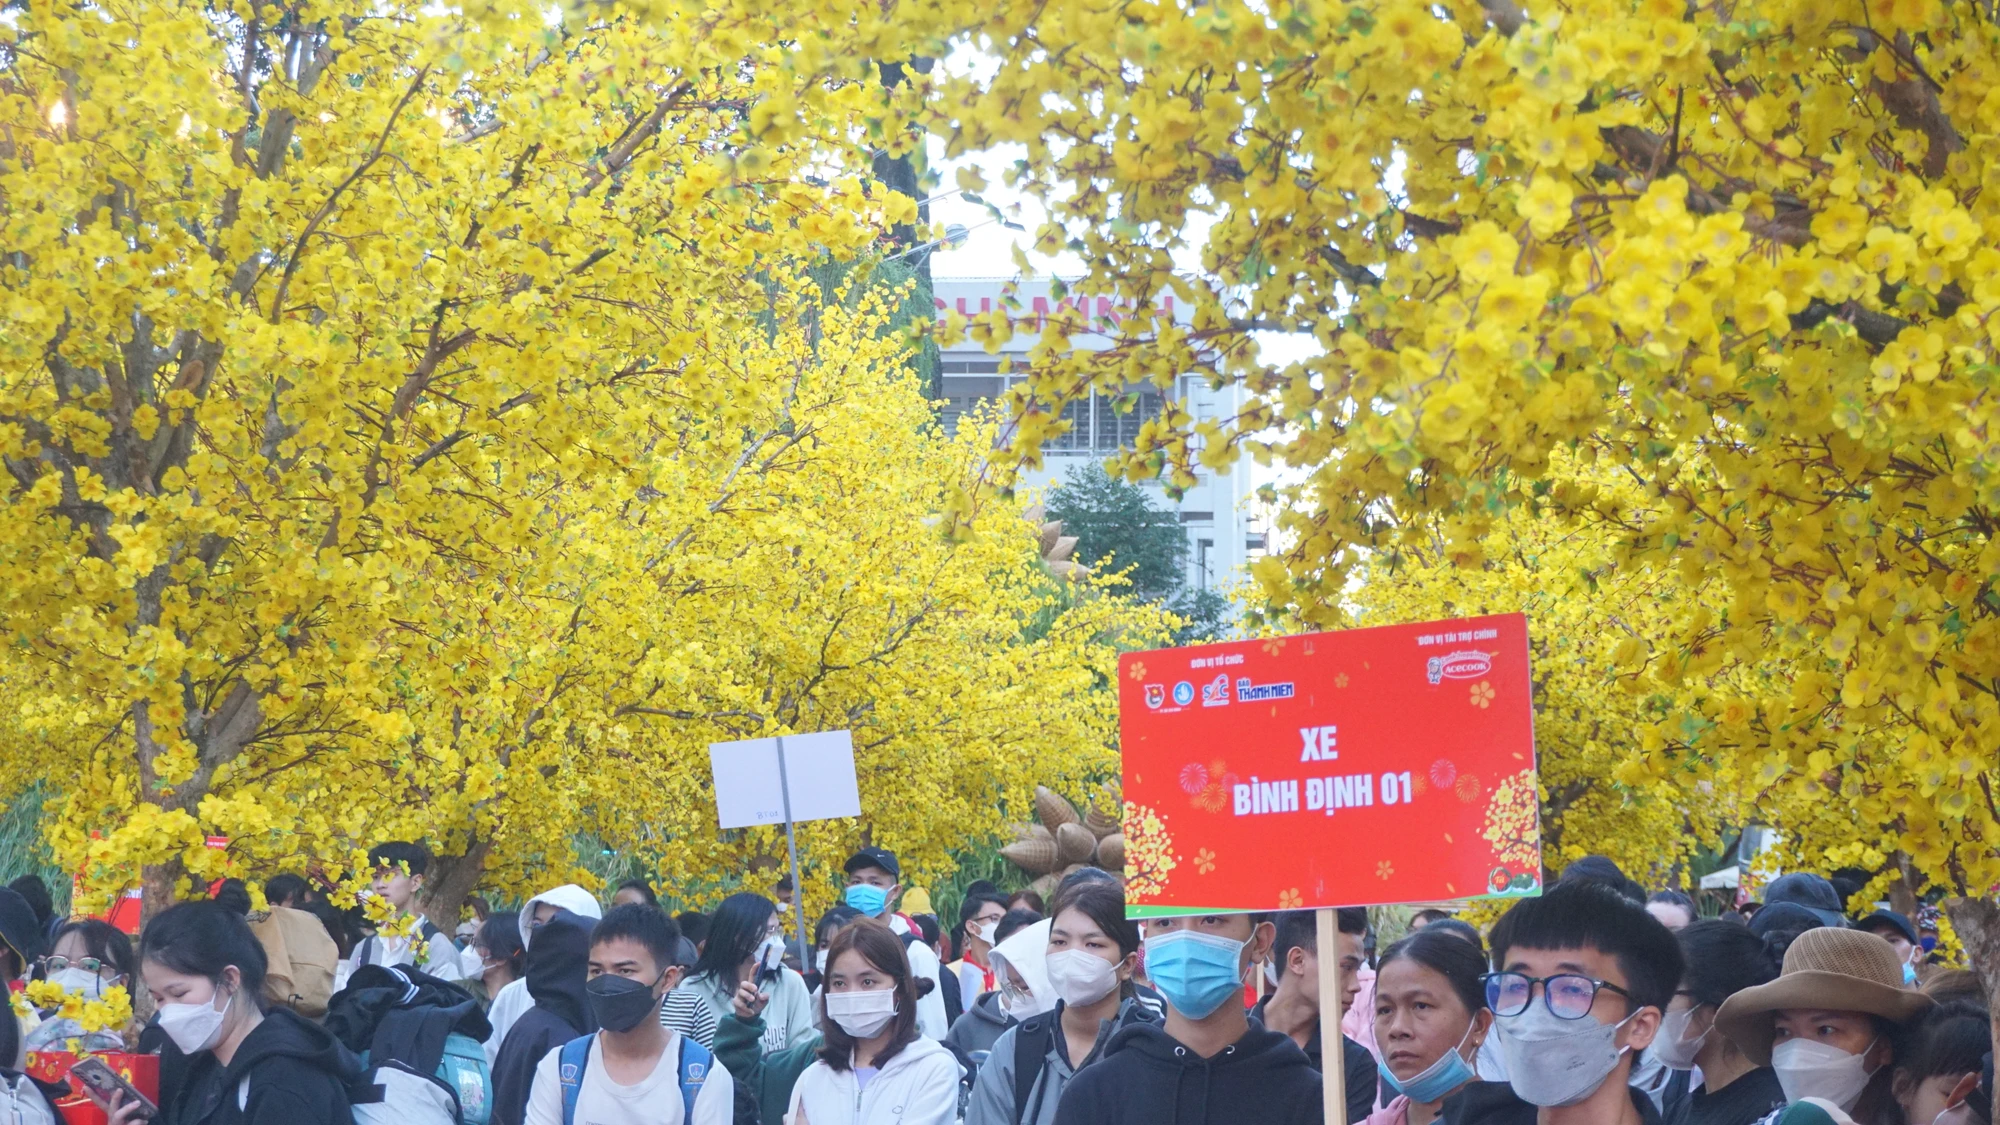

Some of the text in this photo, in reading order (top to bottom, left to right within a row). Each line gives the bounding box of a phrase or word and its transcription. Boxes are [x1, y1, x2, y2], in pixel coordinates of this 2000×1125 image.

[1300, 725, 1338, 762] XE
[1233, 771, 1412, 816] BÌNH ĐỊNH 01
